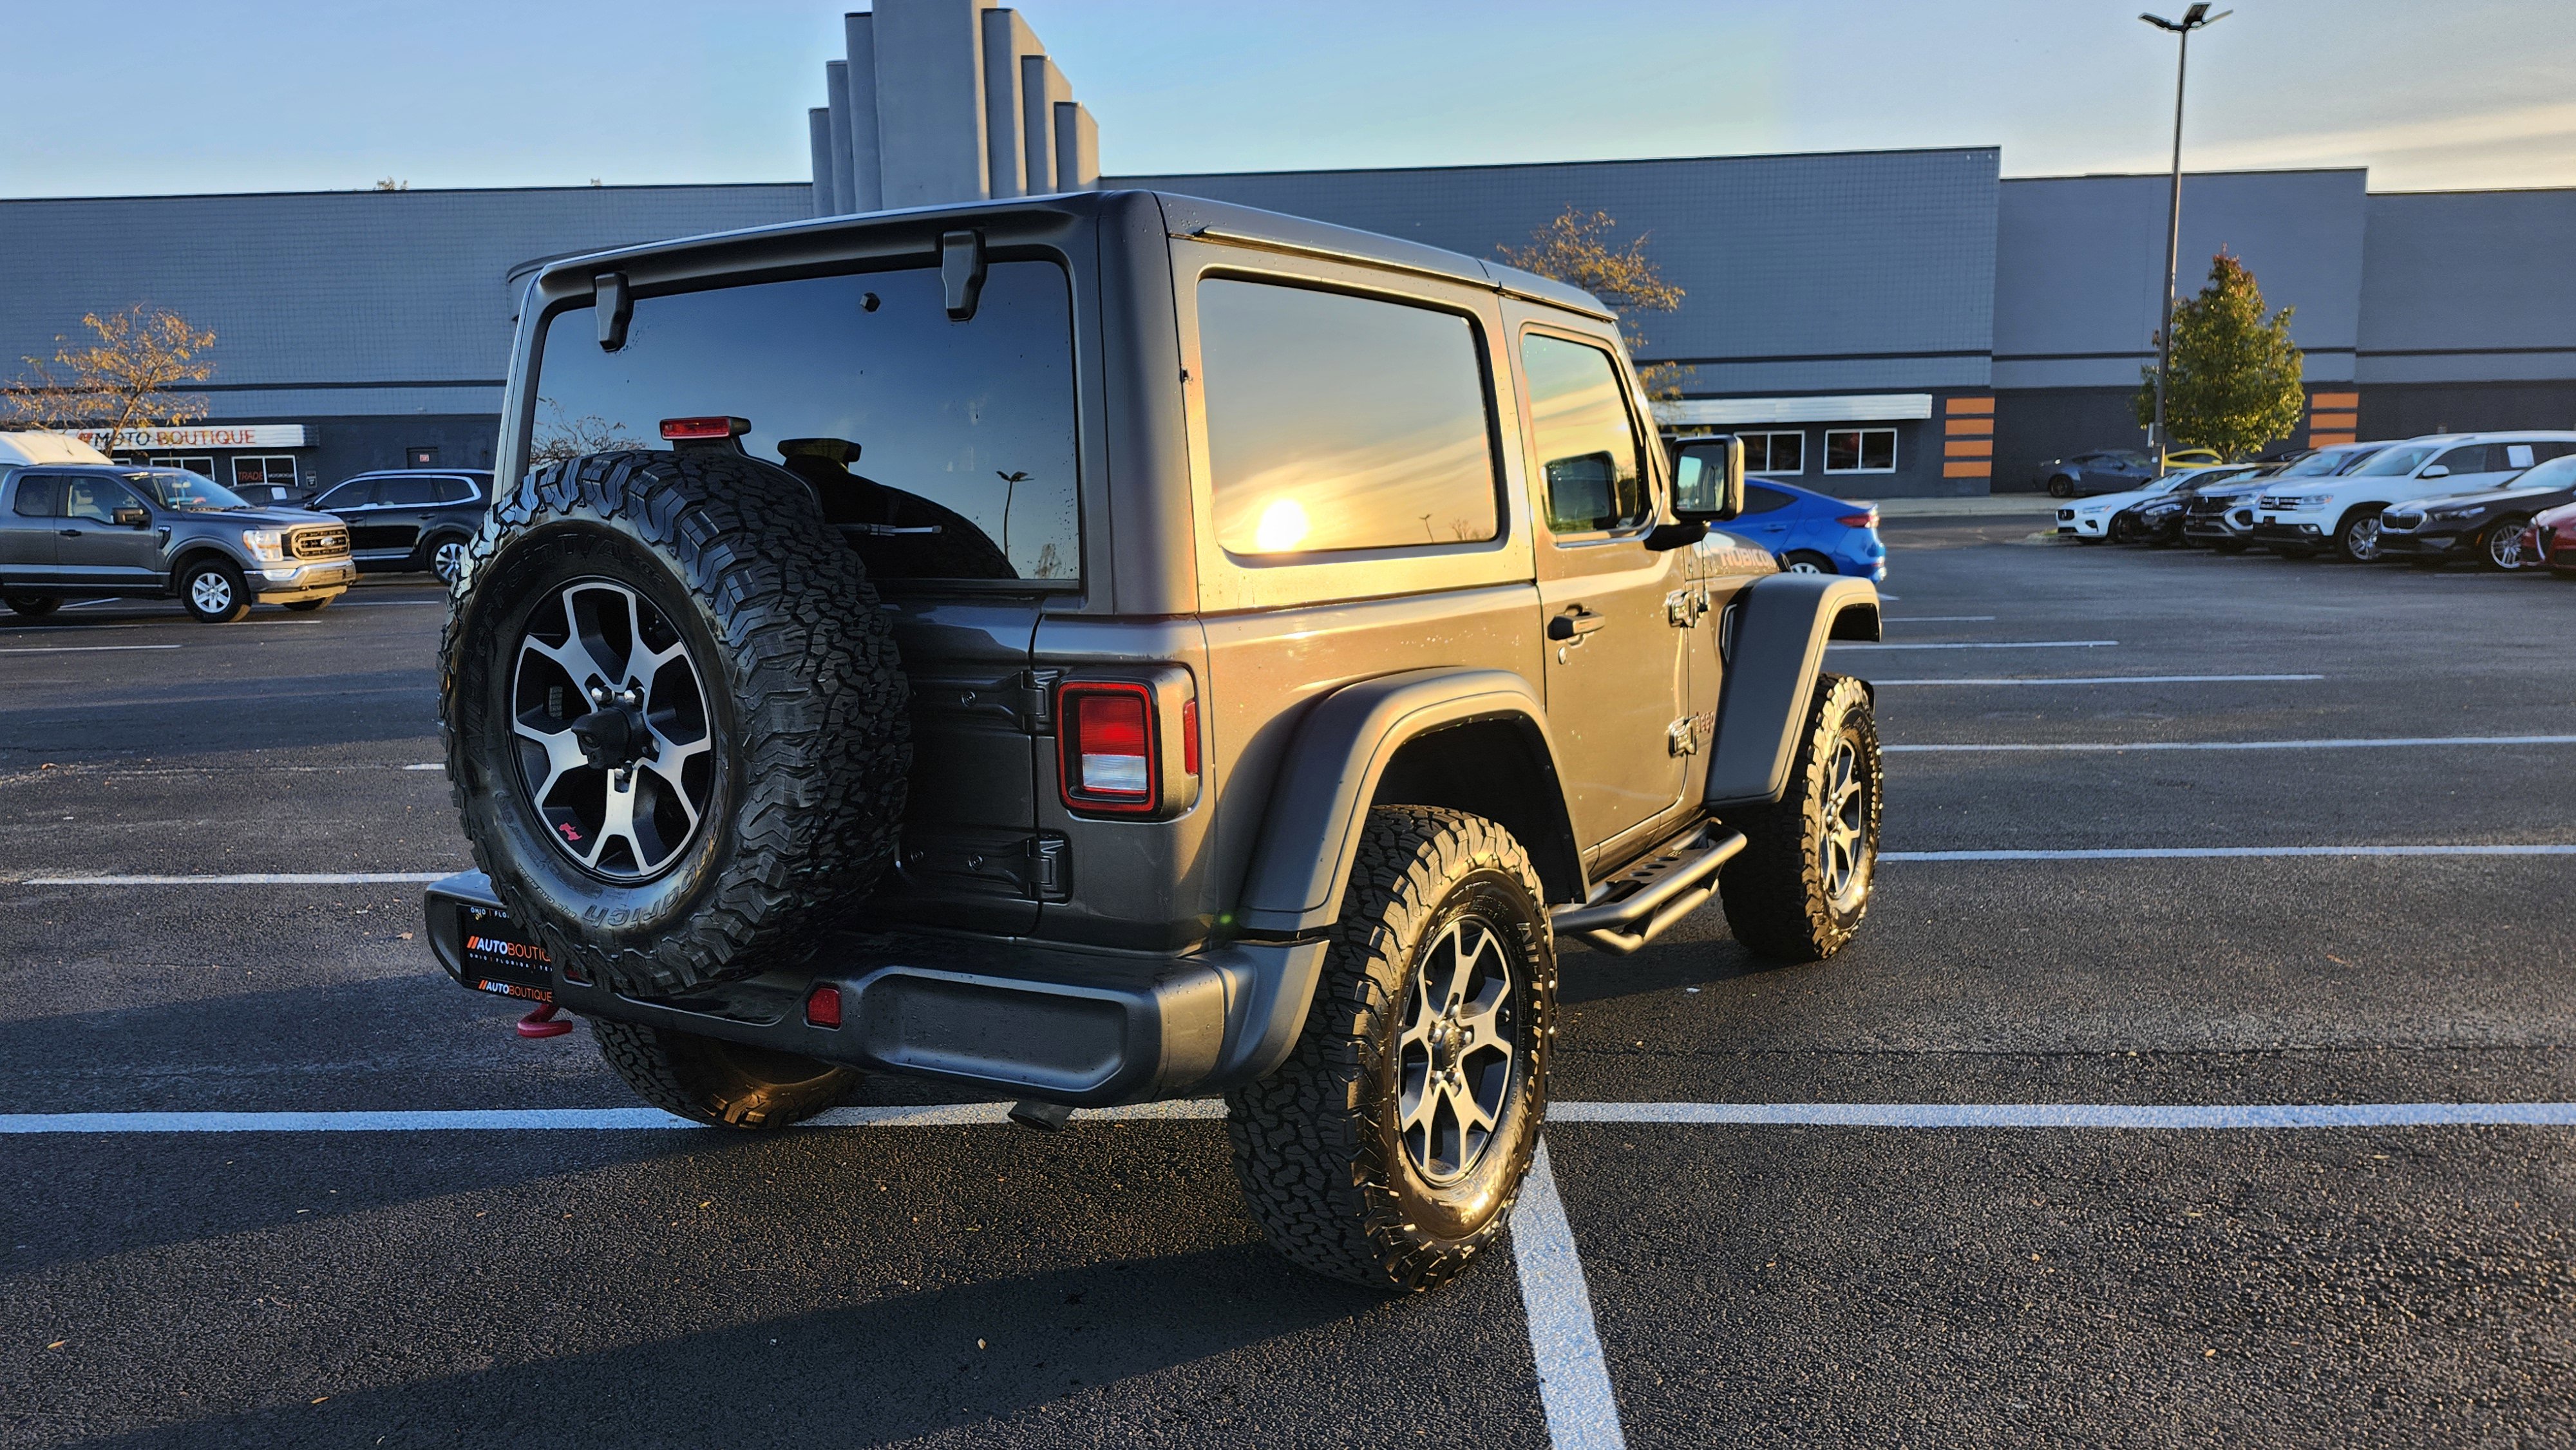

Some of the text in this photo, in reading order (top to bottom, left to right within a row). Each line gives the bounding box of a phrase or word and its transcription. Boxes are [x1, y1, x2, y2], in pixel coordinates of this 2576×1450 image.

[156, 429, 256, 446] BOUTIQUE
[237, 470, 263, 481] TRADE
[470, 907, 486, 915] OHIO
